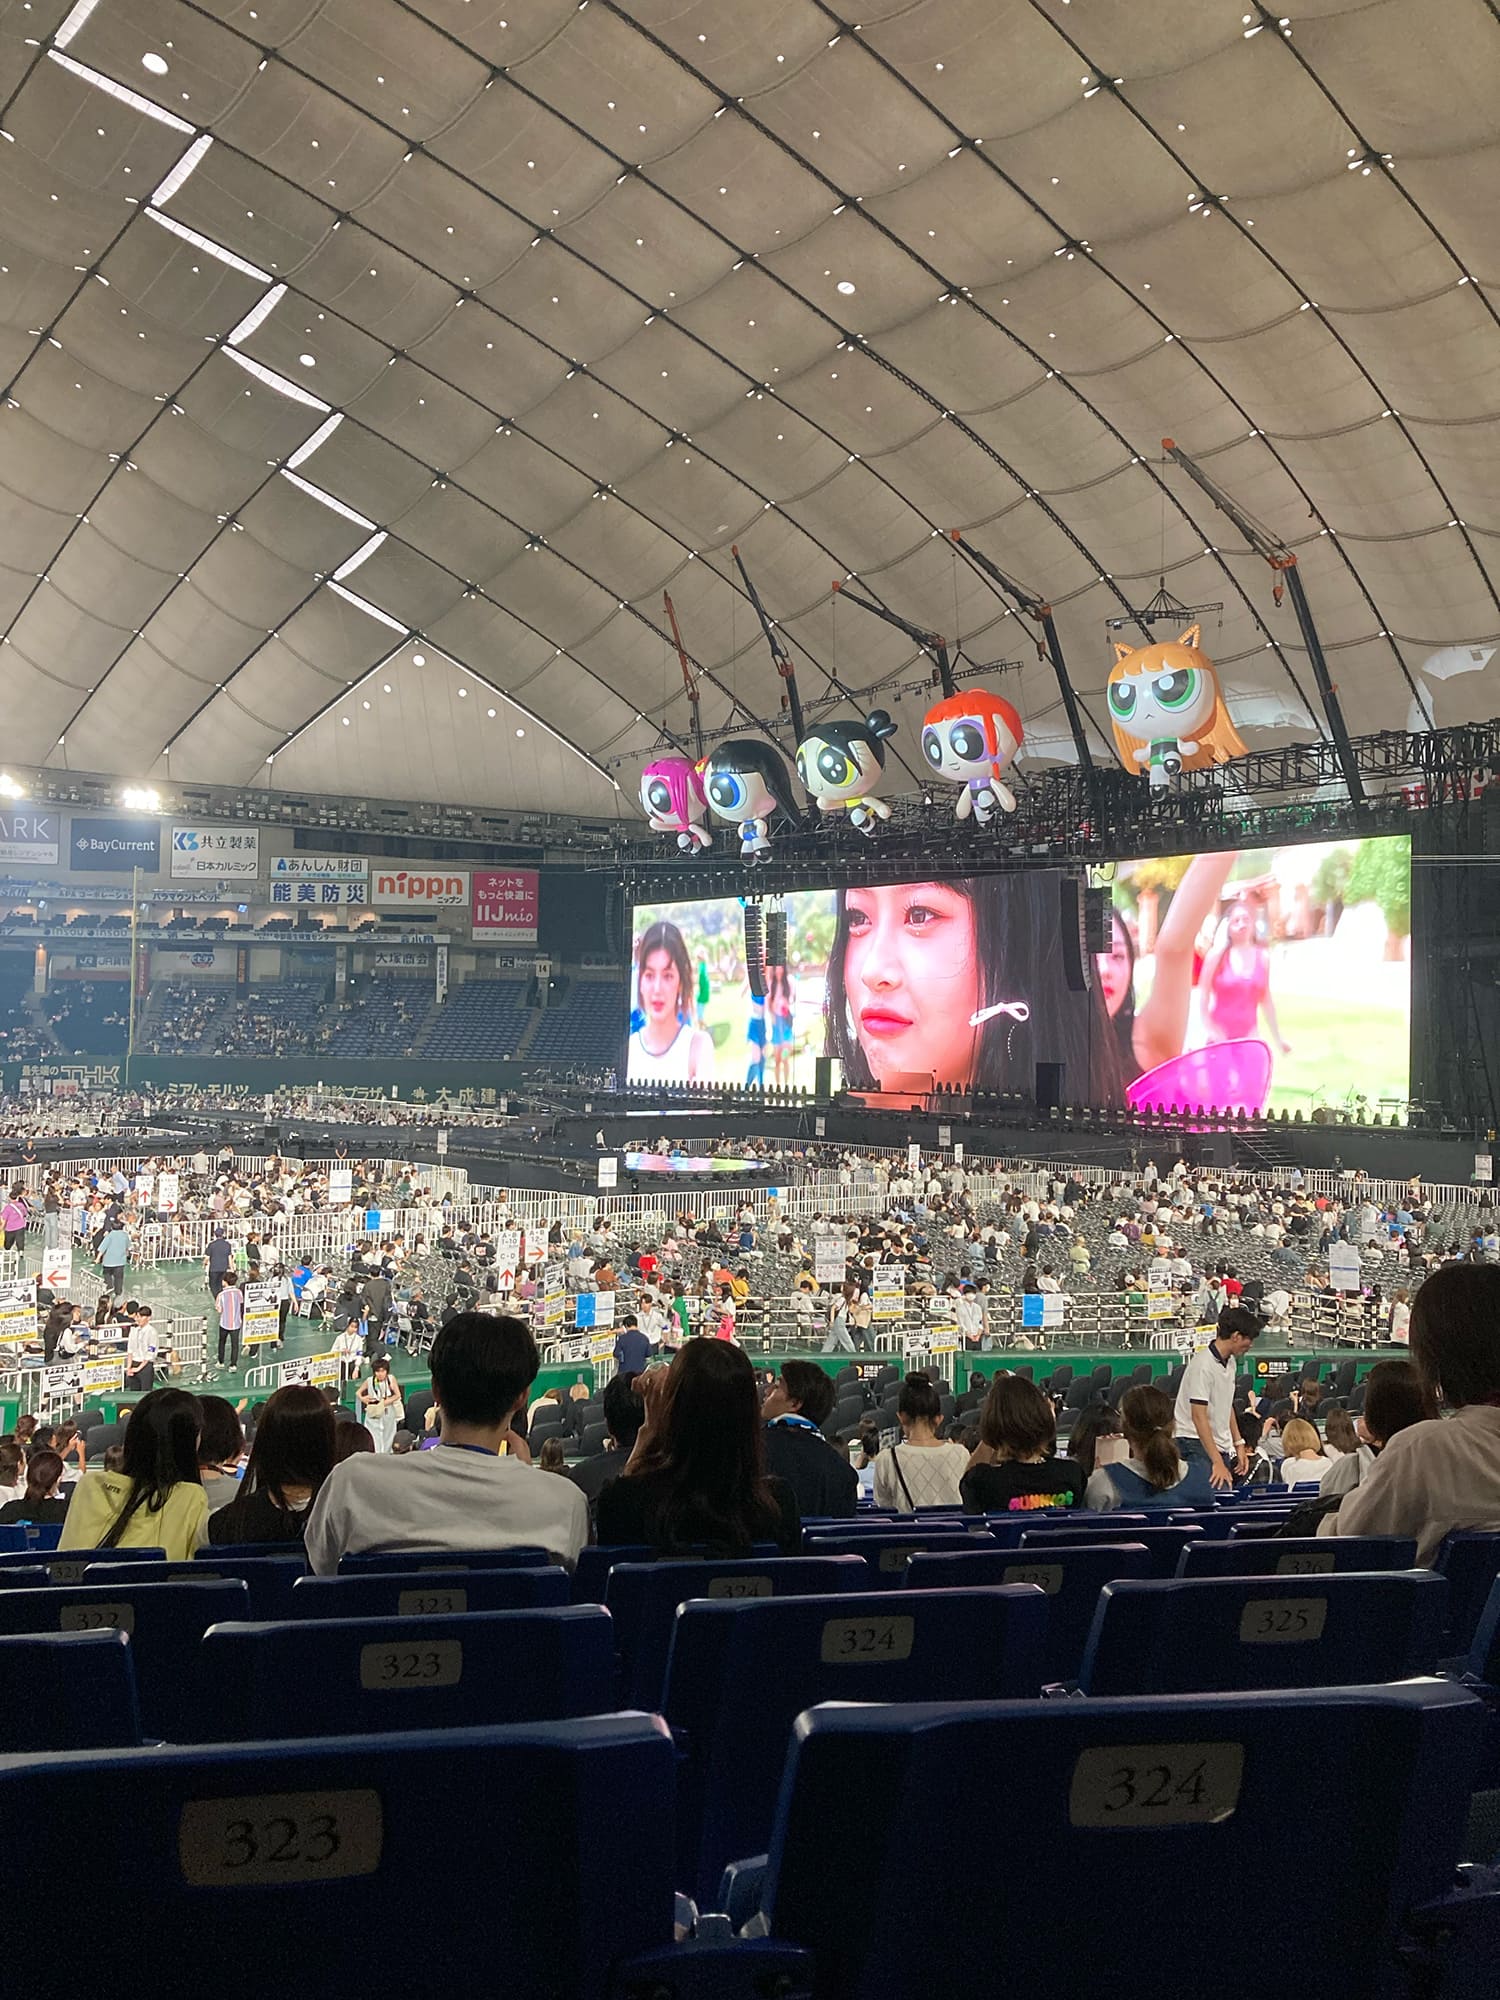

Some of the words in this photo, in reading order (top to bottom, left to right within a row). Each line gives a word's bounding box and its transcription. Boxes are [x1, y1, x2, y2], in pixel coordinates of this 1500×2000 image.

[90, 838, 155, 853] BayCurrent
[200, 835, 257, 849] 共立製薬
[197, 861, 257, 872] 日本カルミック
[288, 859, 362, 873] あんしん財団
[378, 872, 463, 899] nippn
[488, 877, 525, 888] ネットを
[273, 883, 364, 903] 能美防災
[477, 890, 534, 901] もっと快適に
[477, 904, 534, 923] IIJmio
[376, 952, 429, 965] 大塚商会
[538, 965, 547, 973] 14
[61, 1065, 120, 1084] THK
[1256, 1607, 1310, 1635] 325
[838, 1625, 896, 1656] 324
[380, 1648, 441, 1681] 323
[1103, 1760, 1208, 1813] 324
[221, 1812, 342, 1869] 323
